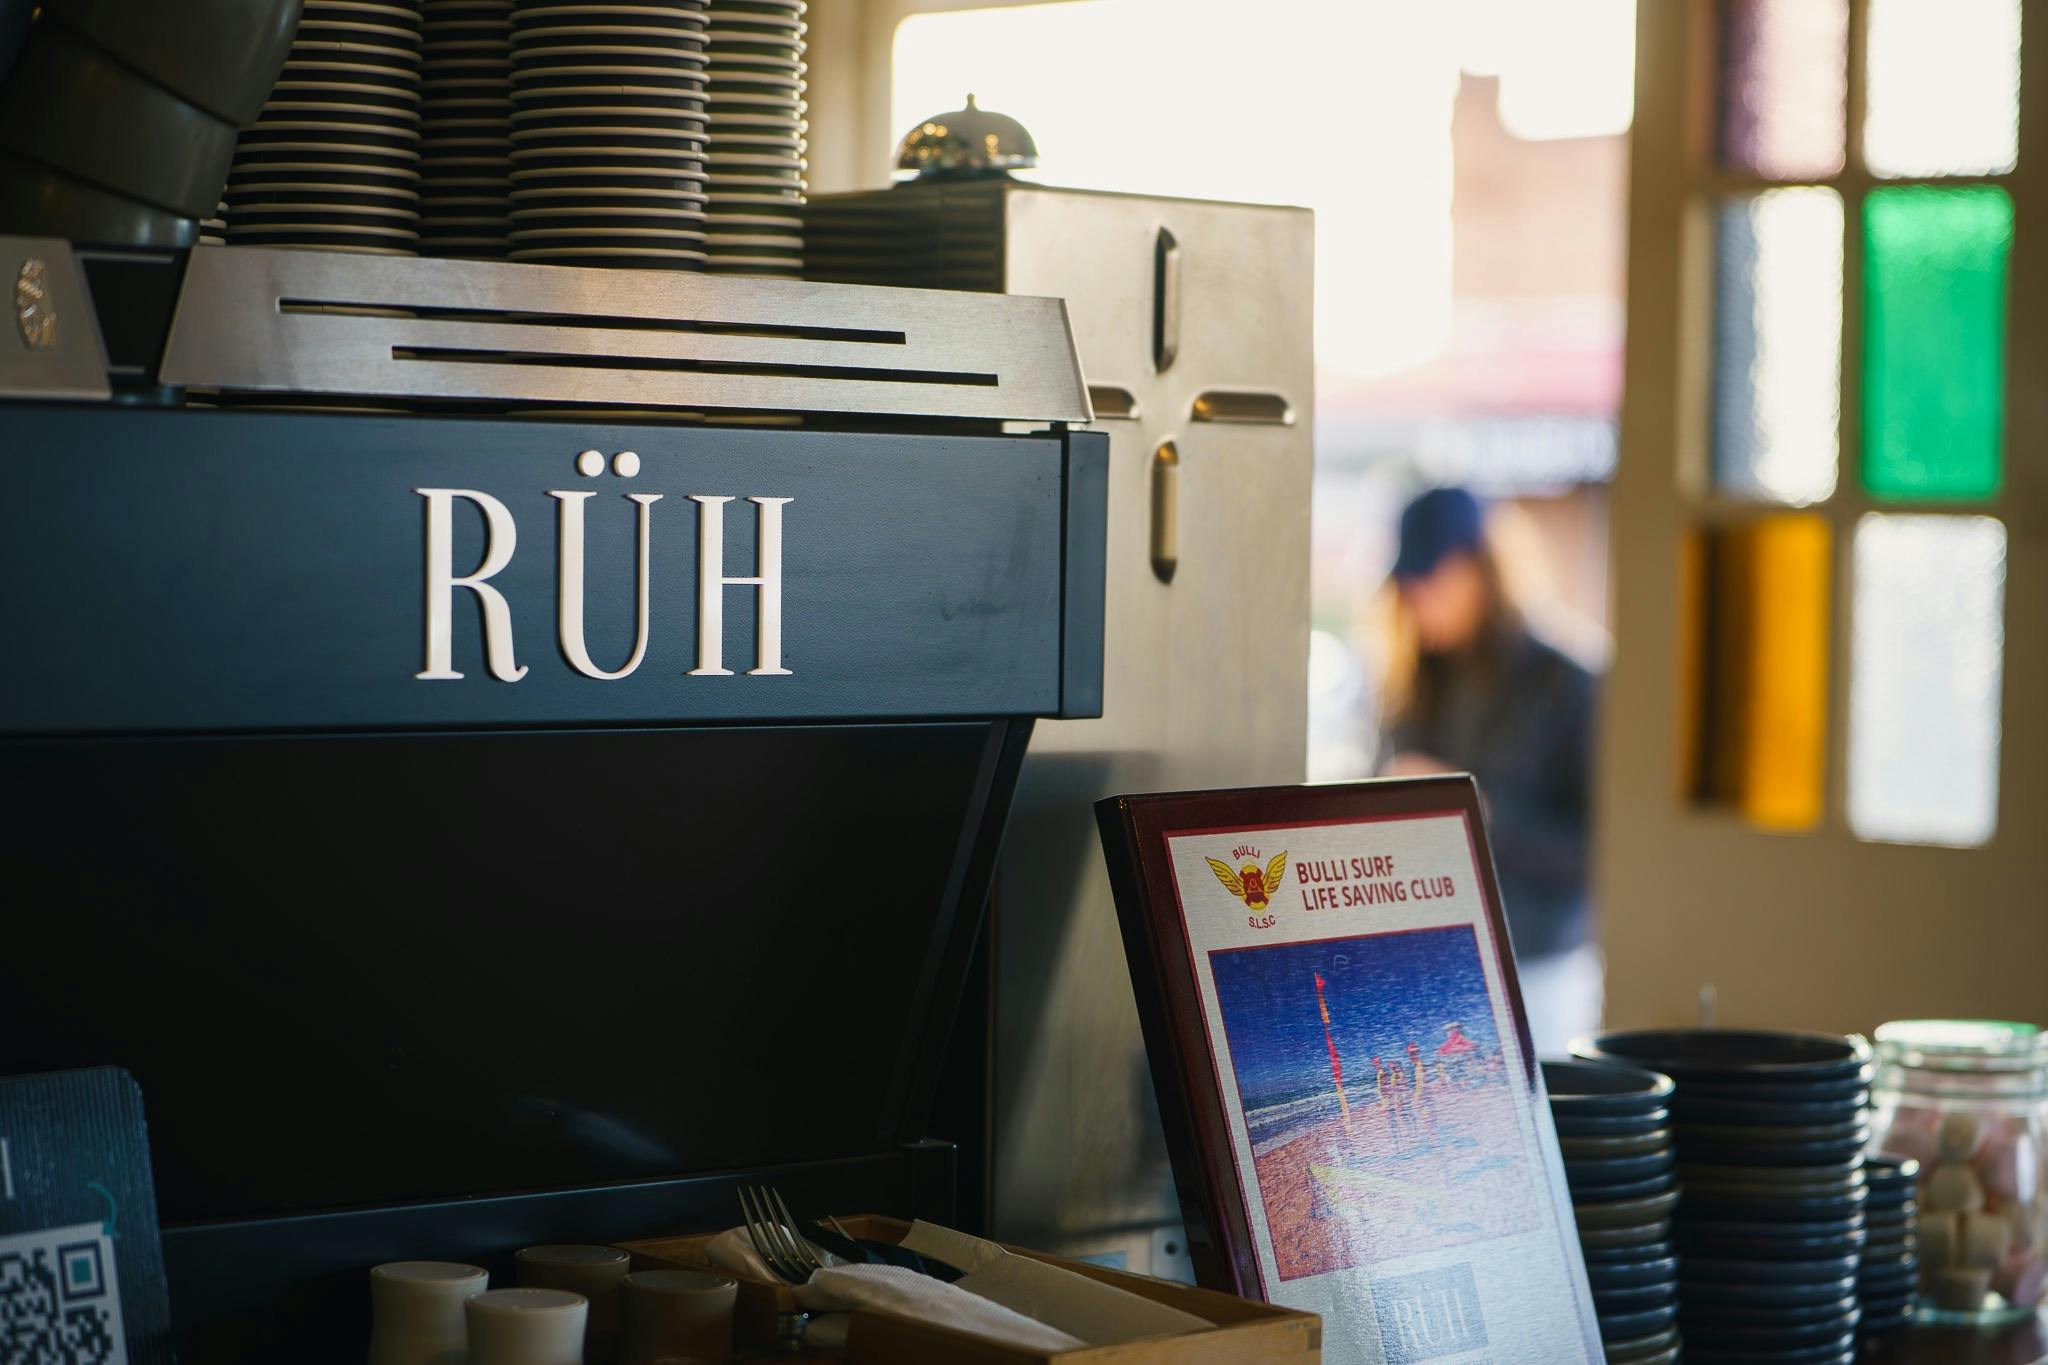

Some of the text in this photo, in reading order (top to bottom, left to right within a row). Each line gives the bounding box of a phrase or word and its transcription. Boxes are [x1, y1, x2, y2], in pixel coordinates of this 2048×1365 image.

[413, 450, 795, 682] RÜH
[1233, 845, 1261, 860] BULLI
[1296, 855, 1395, 884] BULLI SURF
[1301, 876, 1455, 911] LIFE SAVING CLUB
